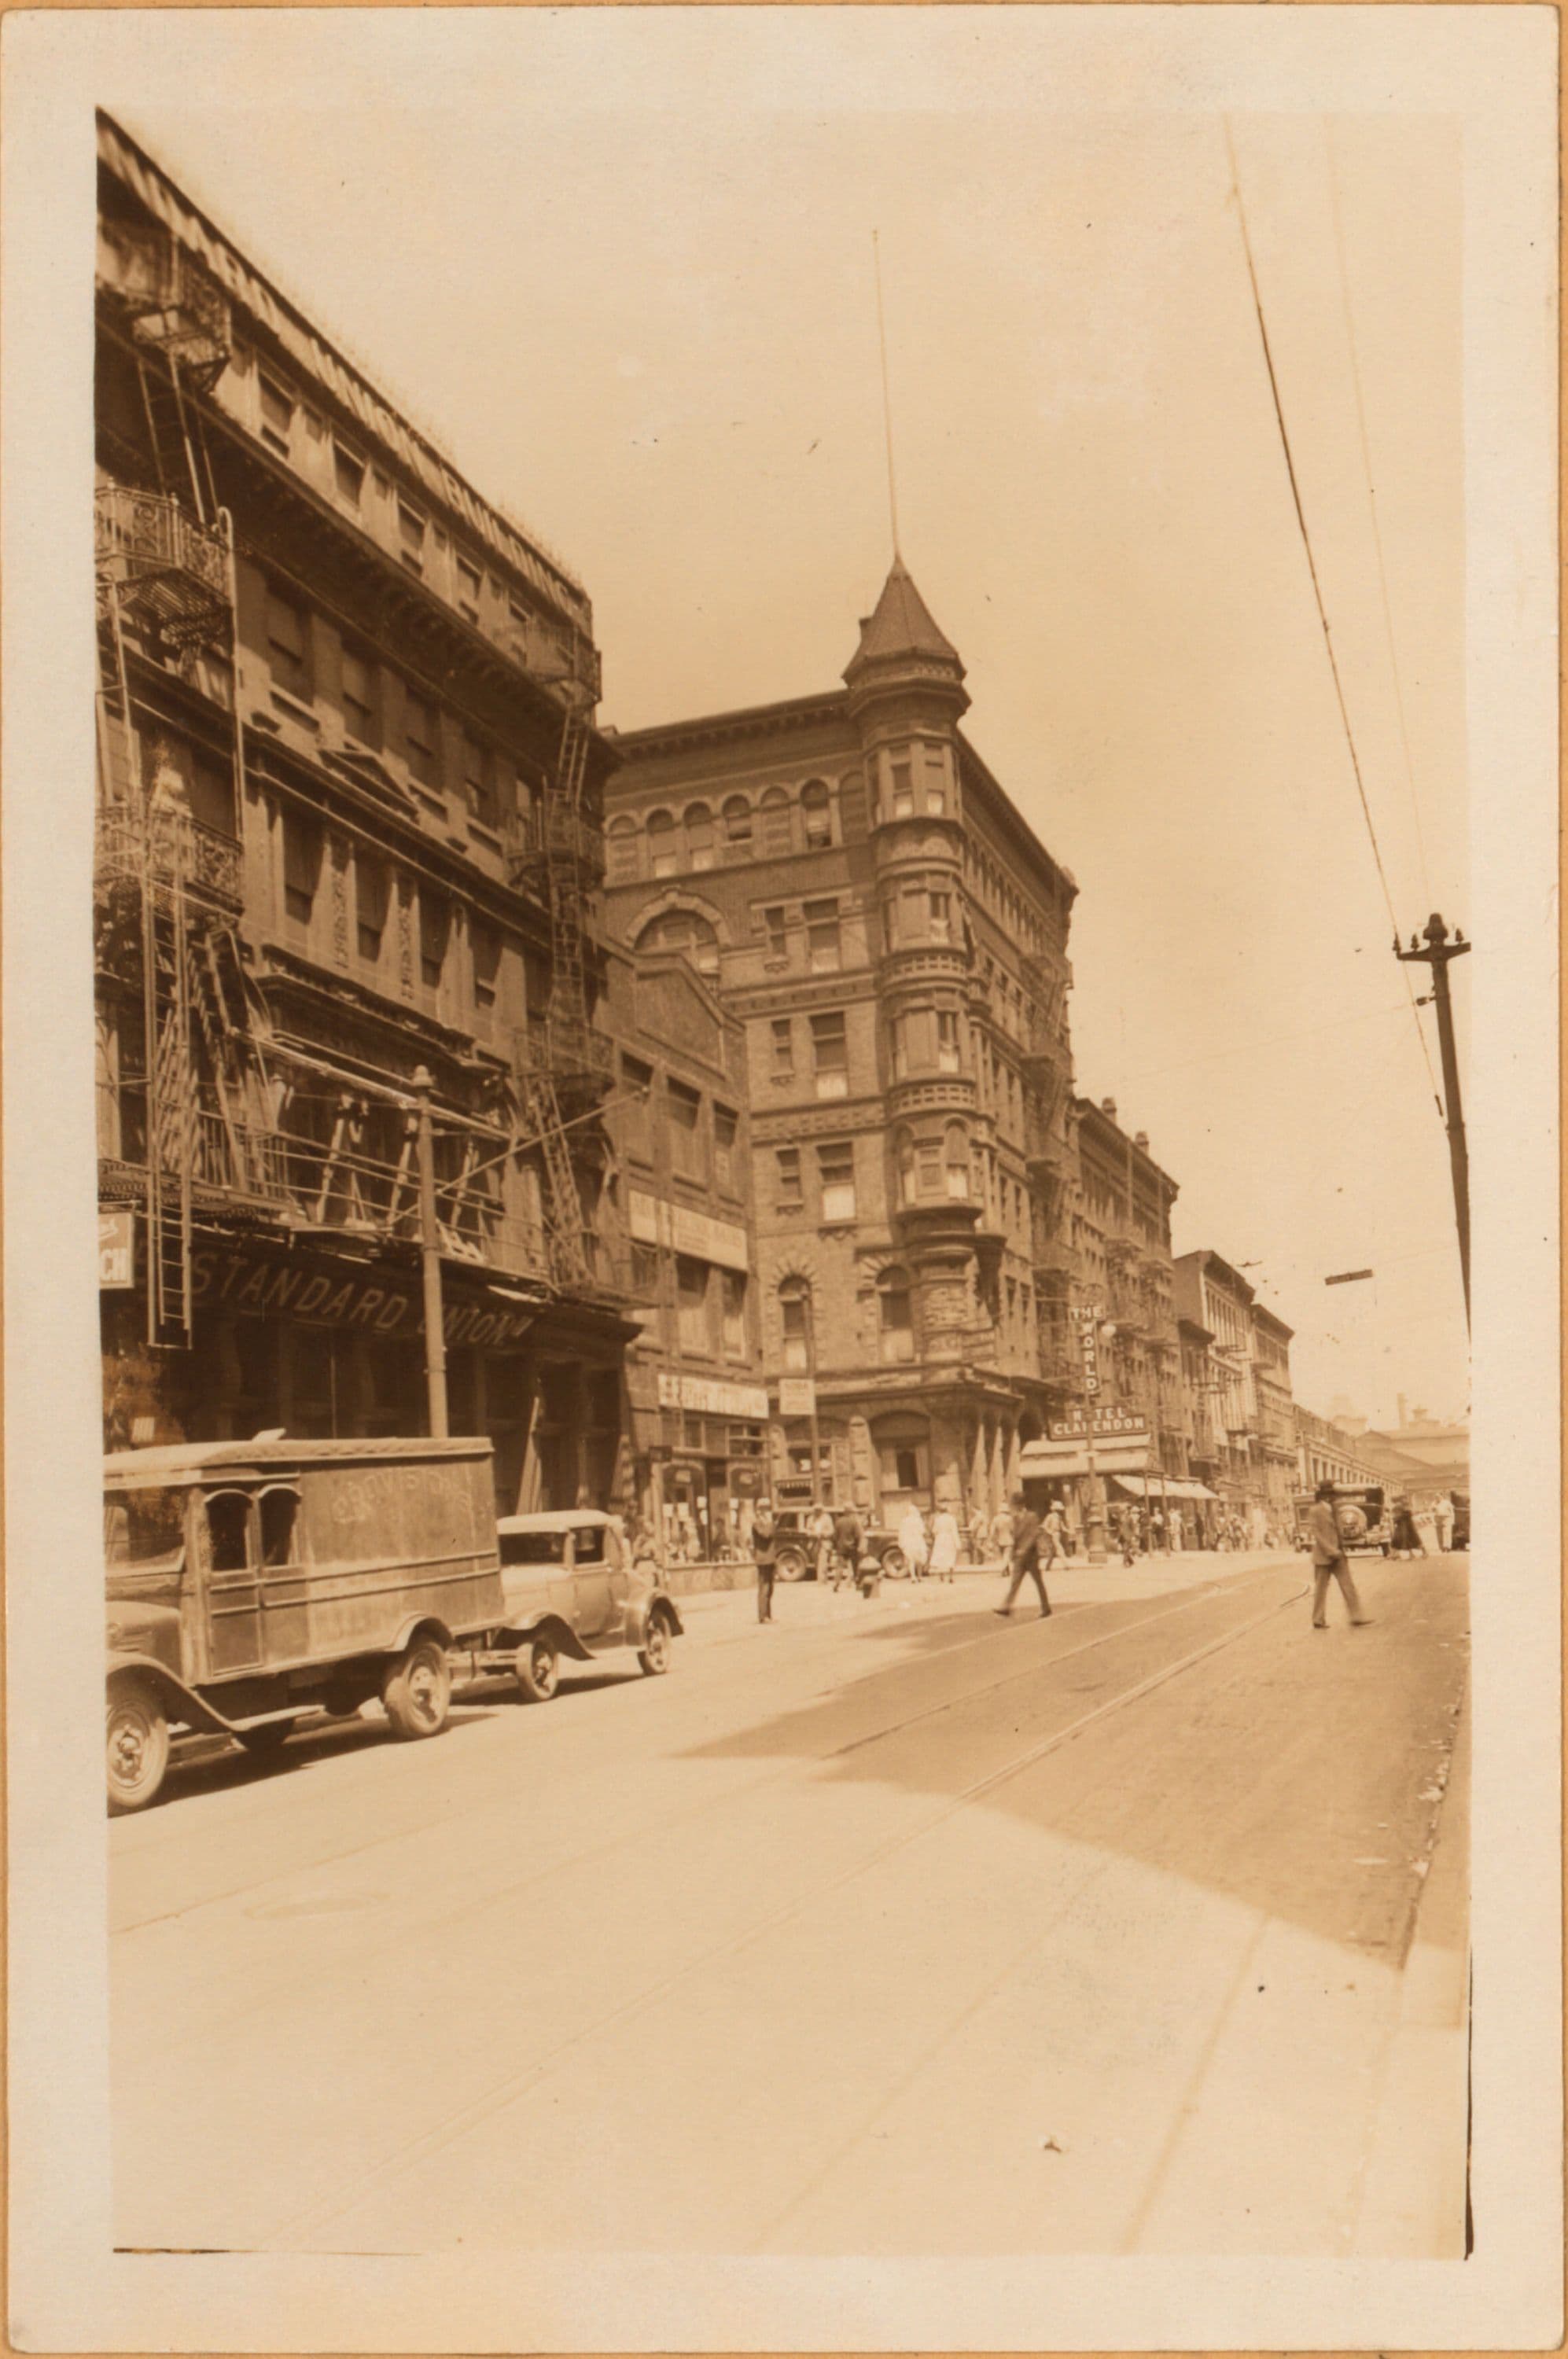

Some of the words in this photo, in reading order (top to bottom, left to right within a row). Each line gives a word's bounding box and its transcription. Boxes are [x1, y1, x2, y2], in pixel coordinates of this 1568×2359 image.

[440, 464, 576, 614] BUILDING
[190, 1252, 409, 1330] STANDARD
[1070, 1306, 1102, 1319] THE
[1081, 1323, 1097, 1390] WORLD
[1073, 1407, 1126, 1422] HTEL
